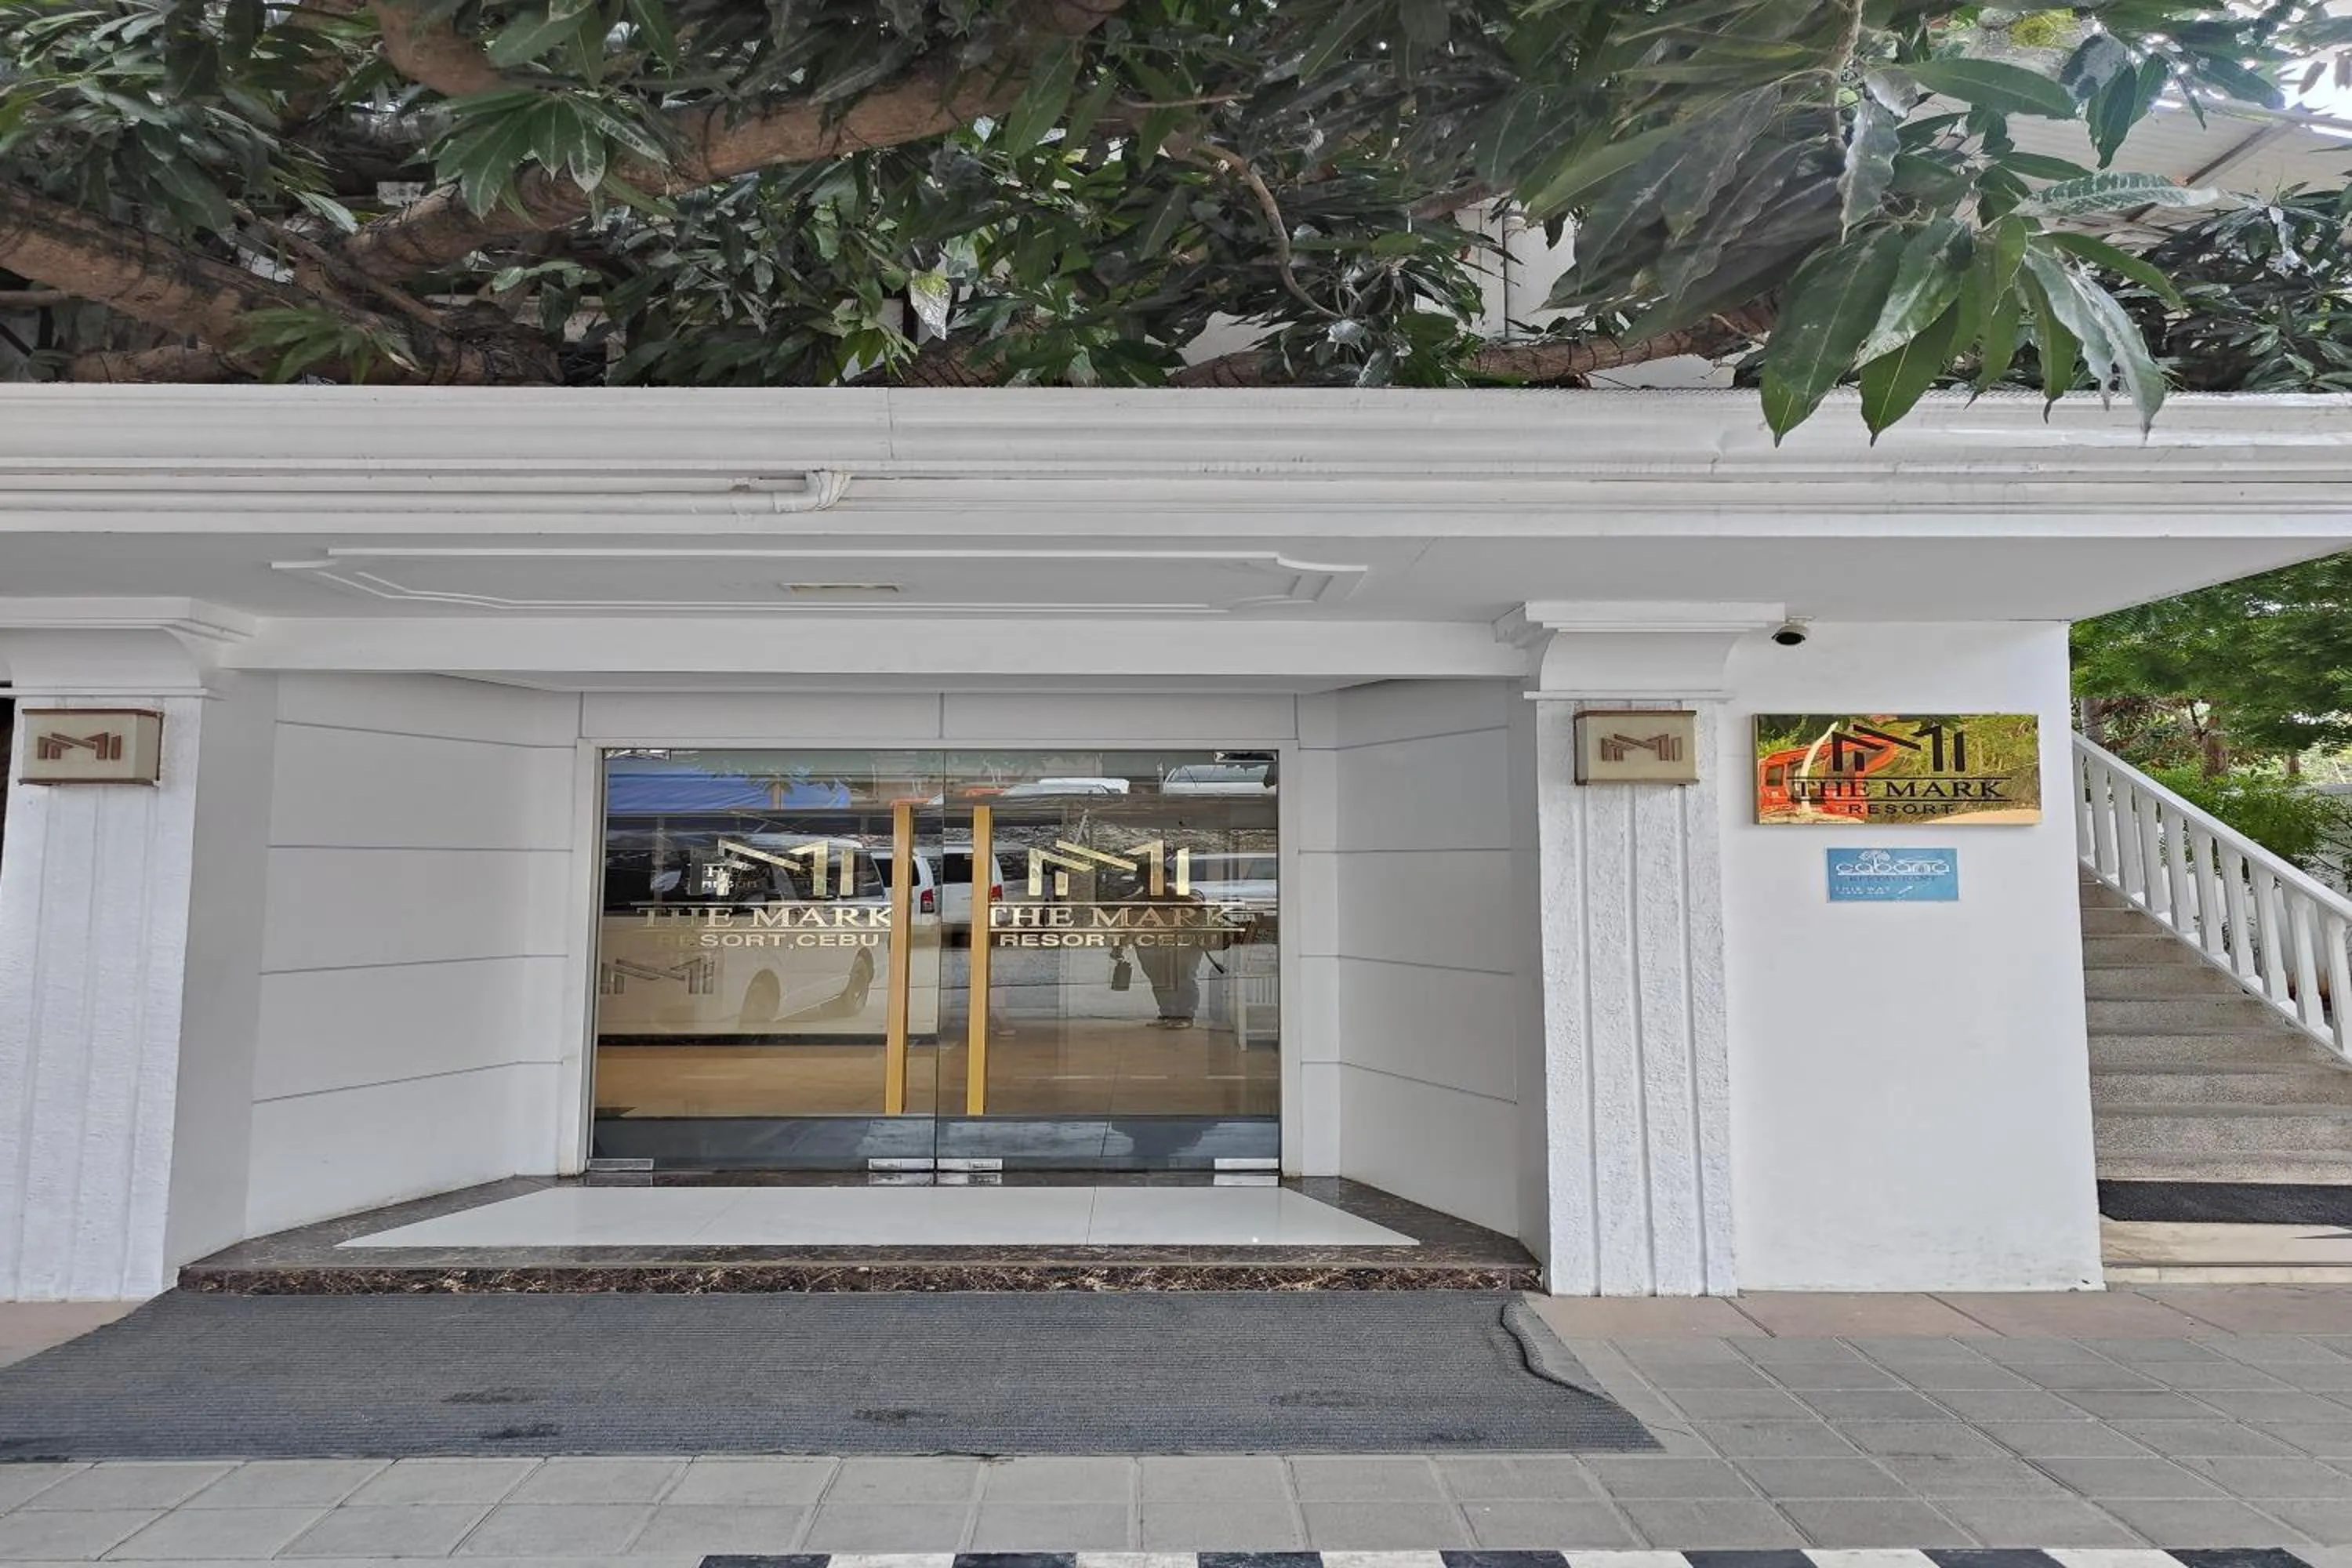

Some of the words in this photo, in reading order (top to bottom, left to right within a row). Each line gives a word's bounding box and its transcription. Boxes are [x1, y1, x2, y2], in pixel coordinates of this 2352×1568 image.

[1791, 780, 1871, 798] THE
[1885, 780, 2005, 798] MARK
[1847, 803, 1955, 815] RESORT
[637, 906, 733, 928] THE
[750, 906, 892, 928] MARK
[989, 906, 1075, 928] THE
[1091, 906, 1238, 928] MARK
